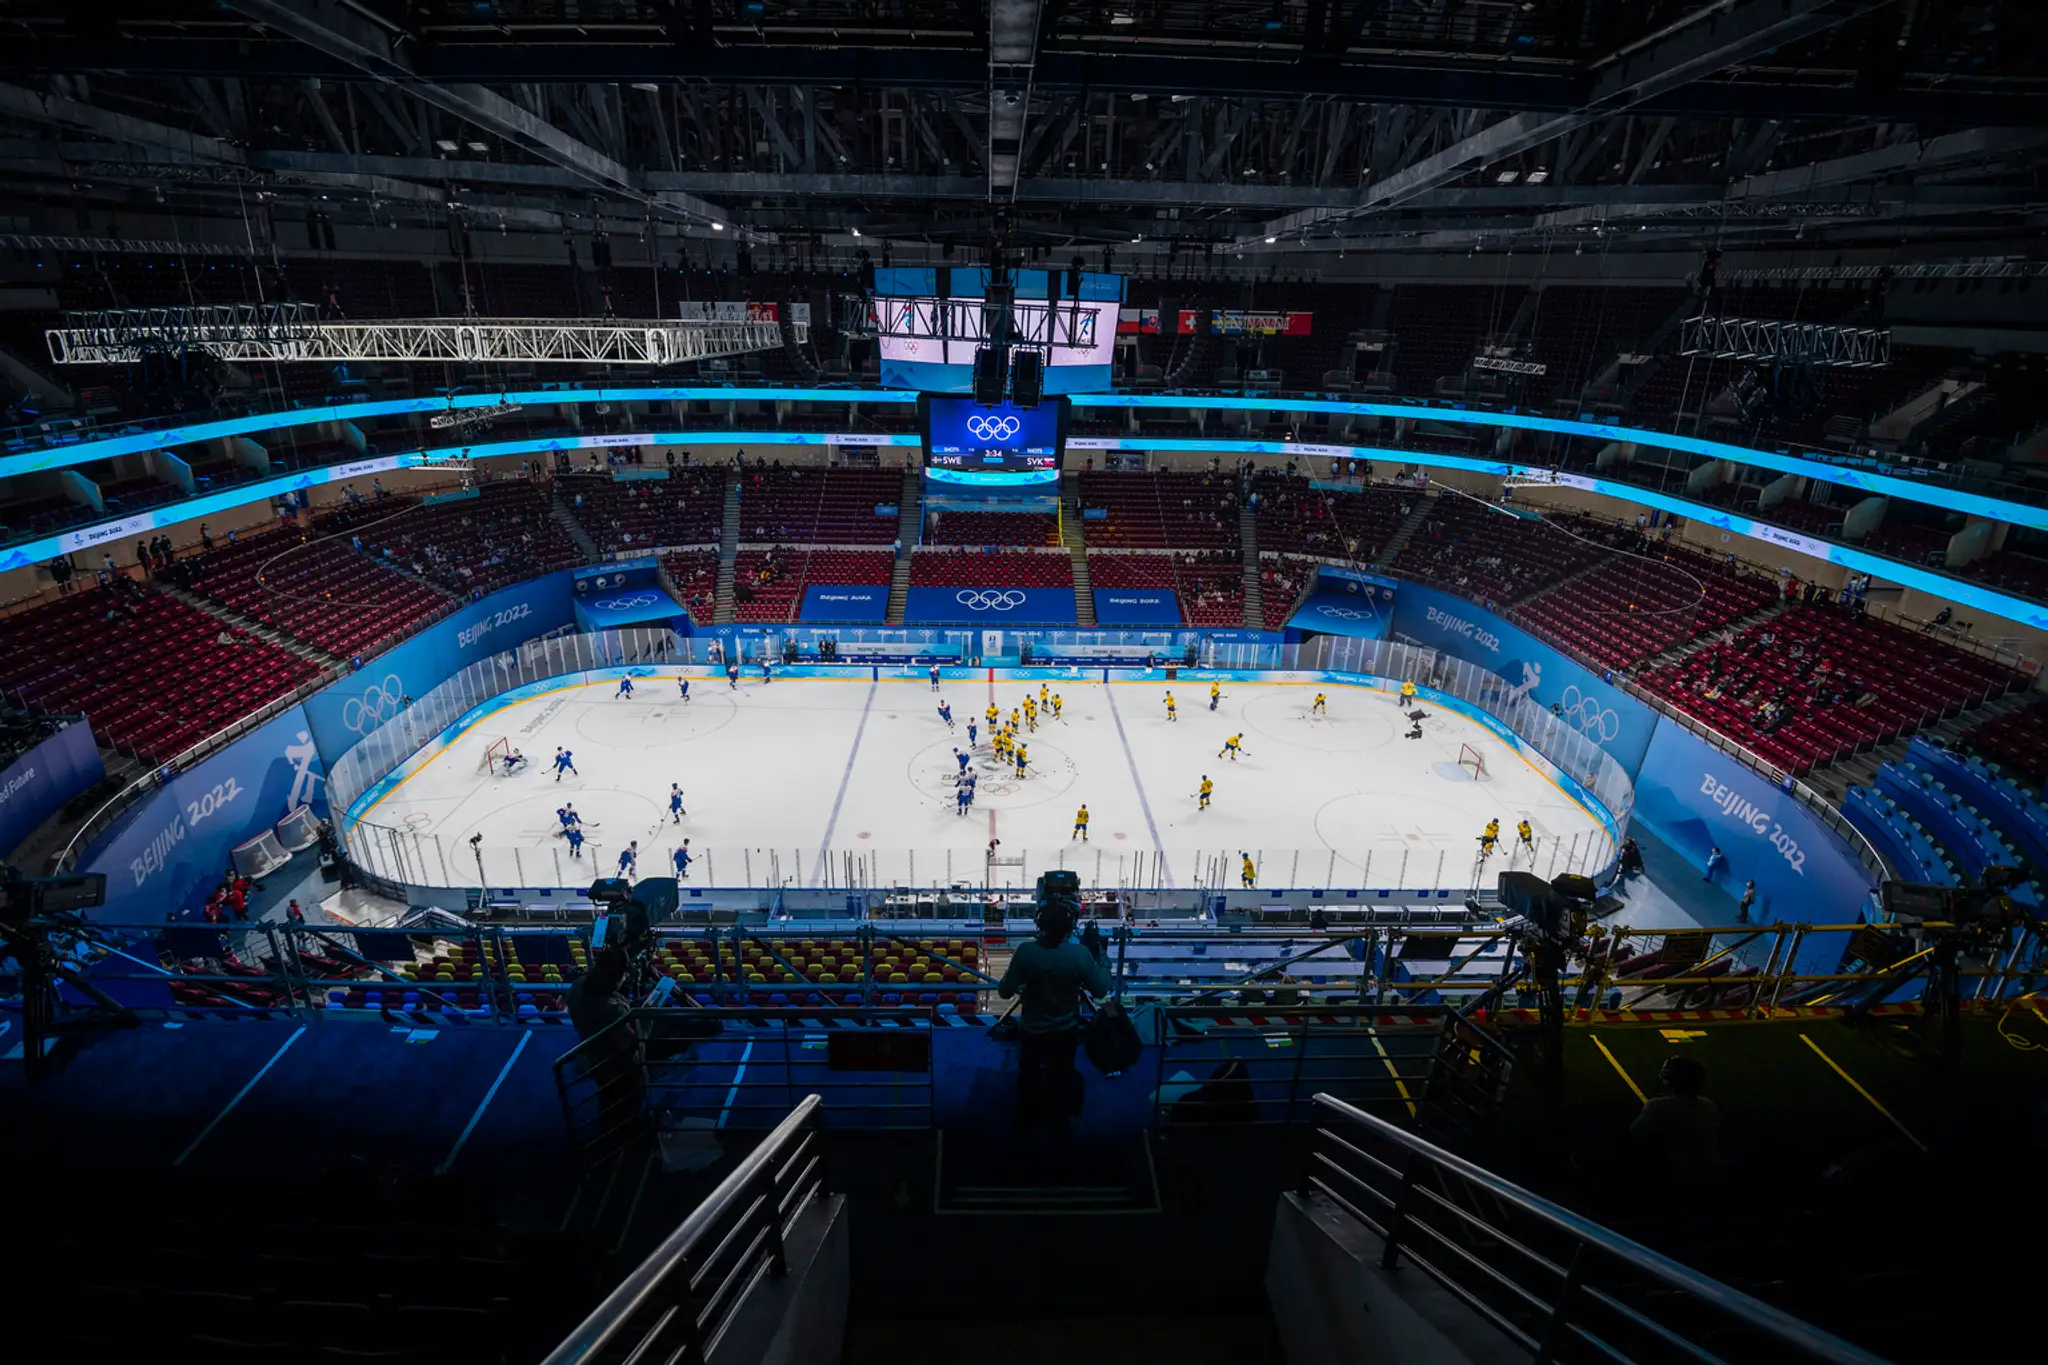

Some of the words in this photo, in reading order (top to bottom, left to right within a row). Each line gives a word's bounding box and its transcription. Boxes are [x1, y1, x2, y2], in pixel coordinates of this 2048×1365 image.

[942, 455, 962, 465] SWE
[1026, 457, 1044, 466] SVK
[457, 616, 492, 649] BEIJING
[494, 603, 532, 628] 2022
[1426, 606, 1475, 639] BEIJING
[1474, 627, 1500, 653] 2022
[130, 813, 186, 888] BEIJING
[187, 777, 244, 827] 2022
[1700, 773, 1771, 835] BEIJING
[1769, 823, 1805, 877] 2022
